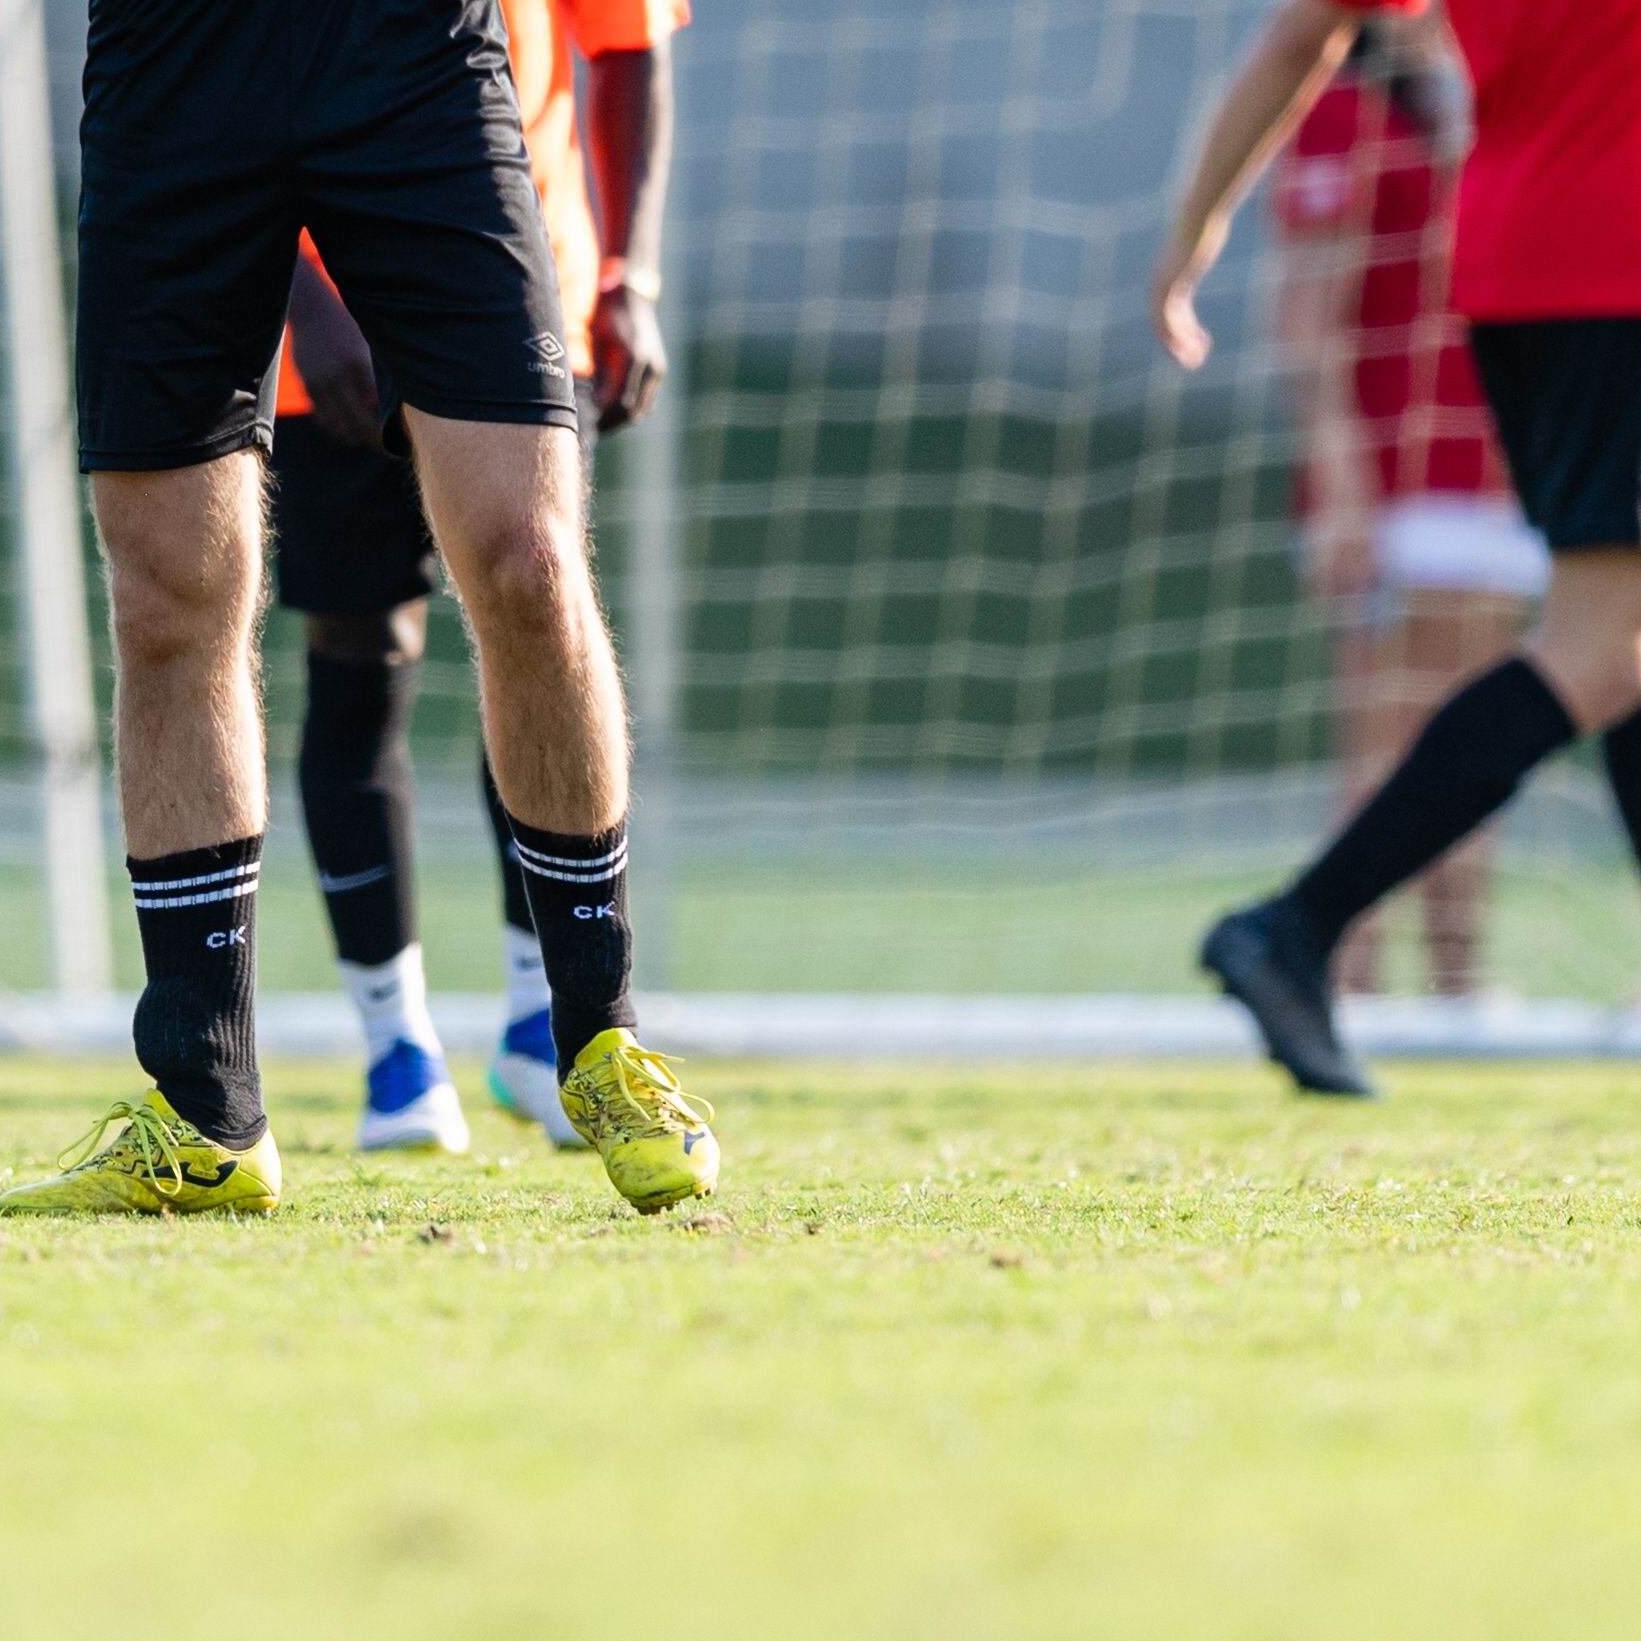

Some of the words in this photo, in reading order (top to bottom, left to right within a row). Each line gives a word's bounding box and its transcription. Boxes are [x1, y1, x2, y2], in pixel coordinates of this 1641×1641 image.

[527, 361, 566, 379] umbro
[573, 900, 616, 920] CK
[206, 925, 246, 949] CK
